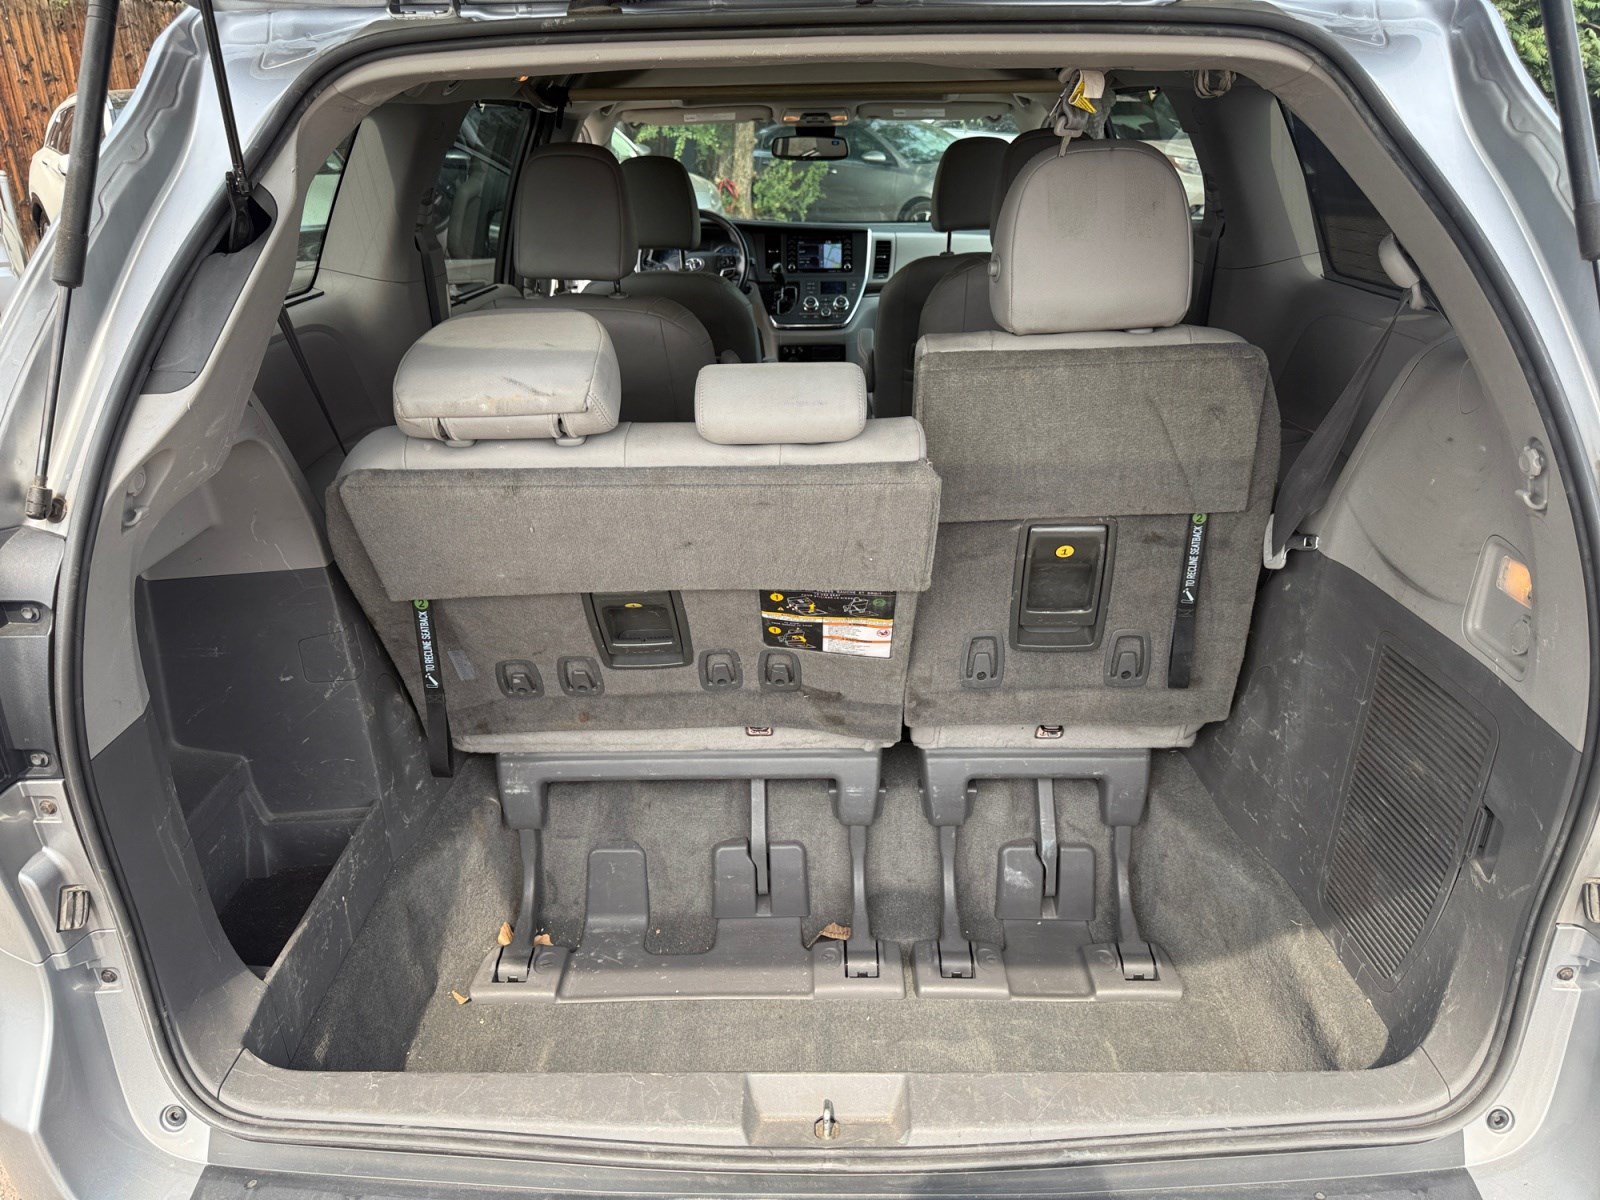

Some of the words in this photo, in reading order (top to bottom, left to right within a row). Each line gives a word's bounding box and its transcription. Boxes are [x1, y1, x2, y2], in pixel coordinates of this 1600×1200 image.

[1190, 525, 1203, 555] SEATBACK
[1187, 556, 1198, 579] RECLINE
[418, 611, 431, 640] SEATBACK
[423, 641, 434, 663] RECLINE
[425, 664, 435, 672] TO
